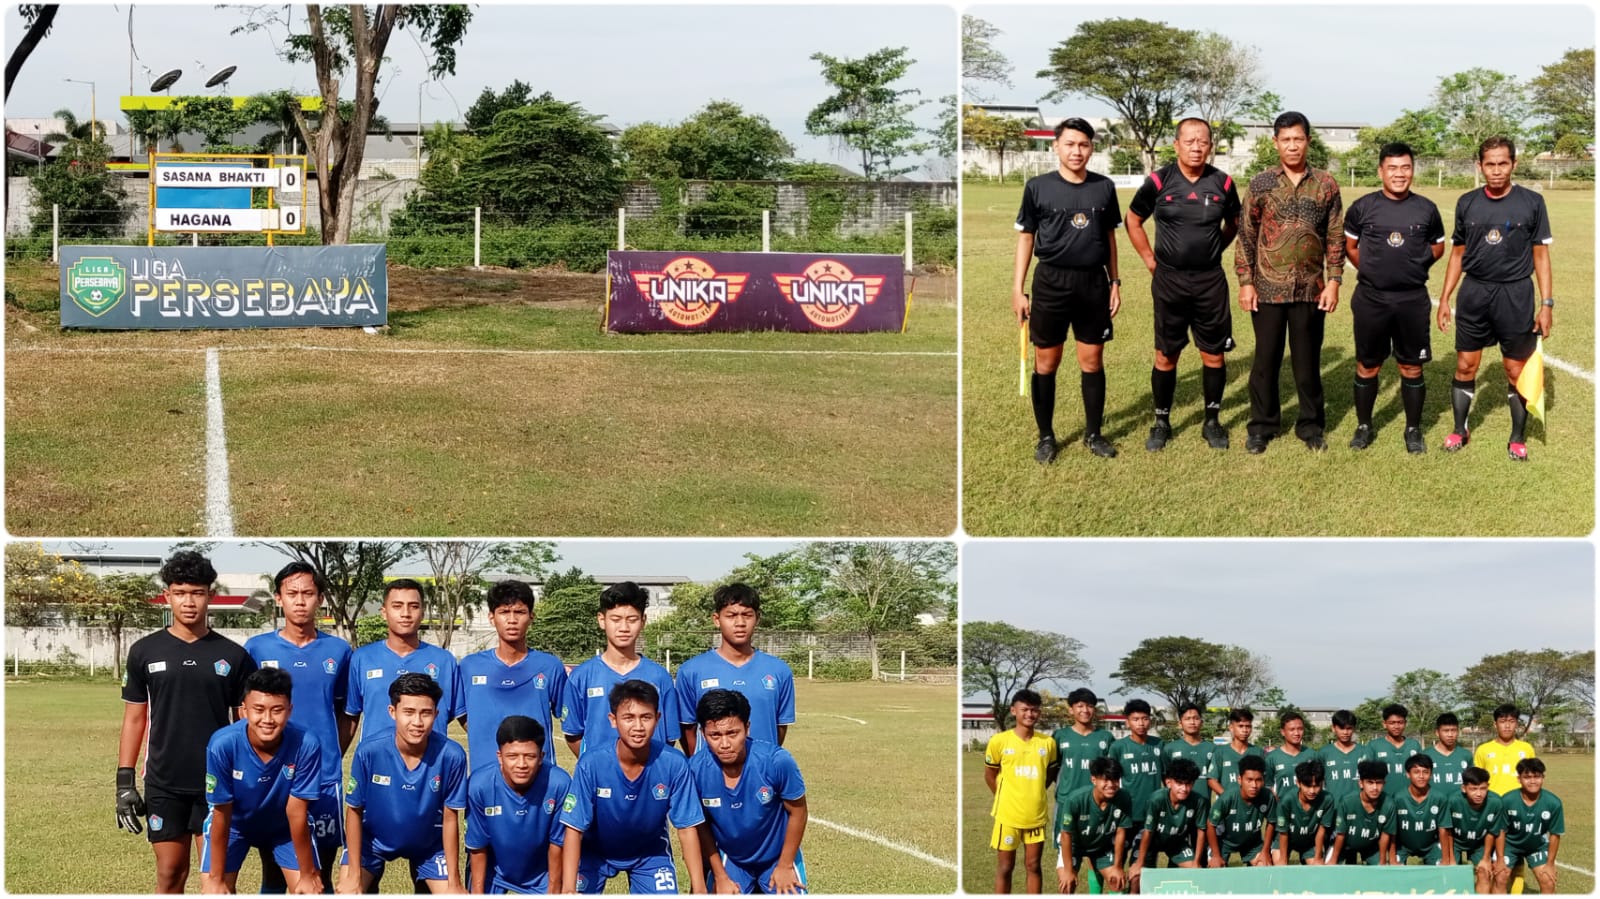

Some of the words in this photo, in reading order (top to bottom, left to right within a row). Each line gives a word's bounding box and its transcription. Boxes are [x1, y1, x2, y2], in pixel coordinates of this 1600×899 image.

[162, 171, 212, 183] SASANA
[219, 171, 266, 183] BHAKTI
[285, 173, 296, 186] 0
[169, 213, 232, 227] HAGANA
[285, 212, 296, 226] 0
[131, 258, 186, 280] LIGA
[74, 276, 119, 289] PERSEBAYA
[130, 277, 380, 318] PERSEBAYA
[650, 276, 728, 305] UNIKA
[791, 278, 865, 307] UNIKA
[668, 307, 711, 321] AUTOMOTIVE
[809, 309, 850, 323] AUTOMOTIVE
[315, 818, 336, 838] 34
[1402, 819, 1437, 831] HMA
[654, 872, 675, 891] 25
